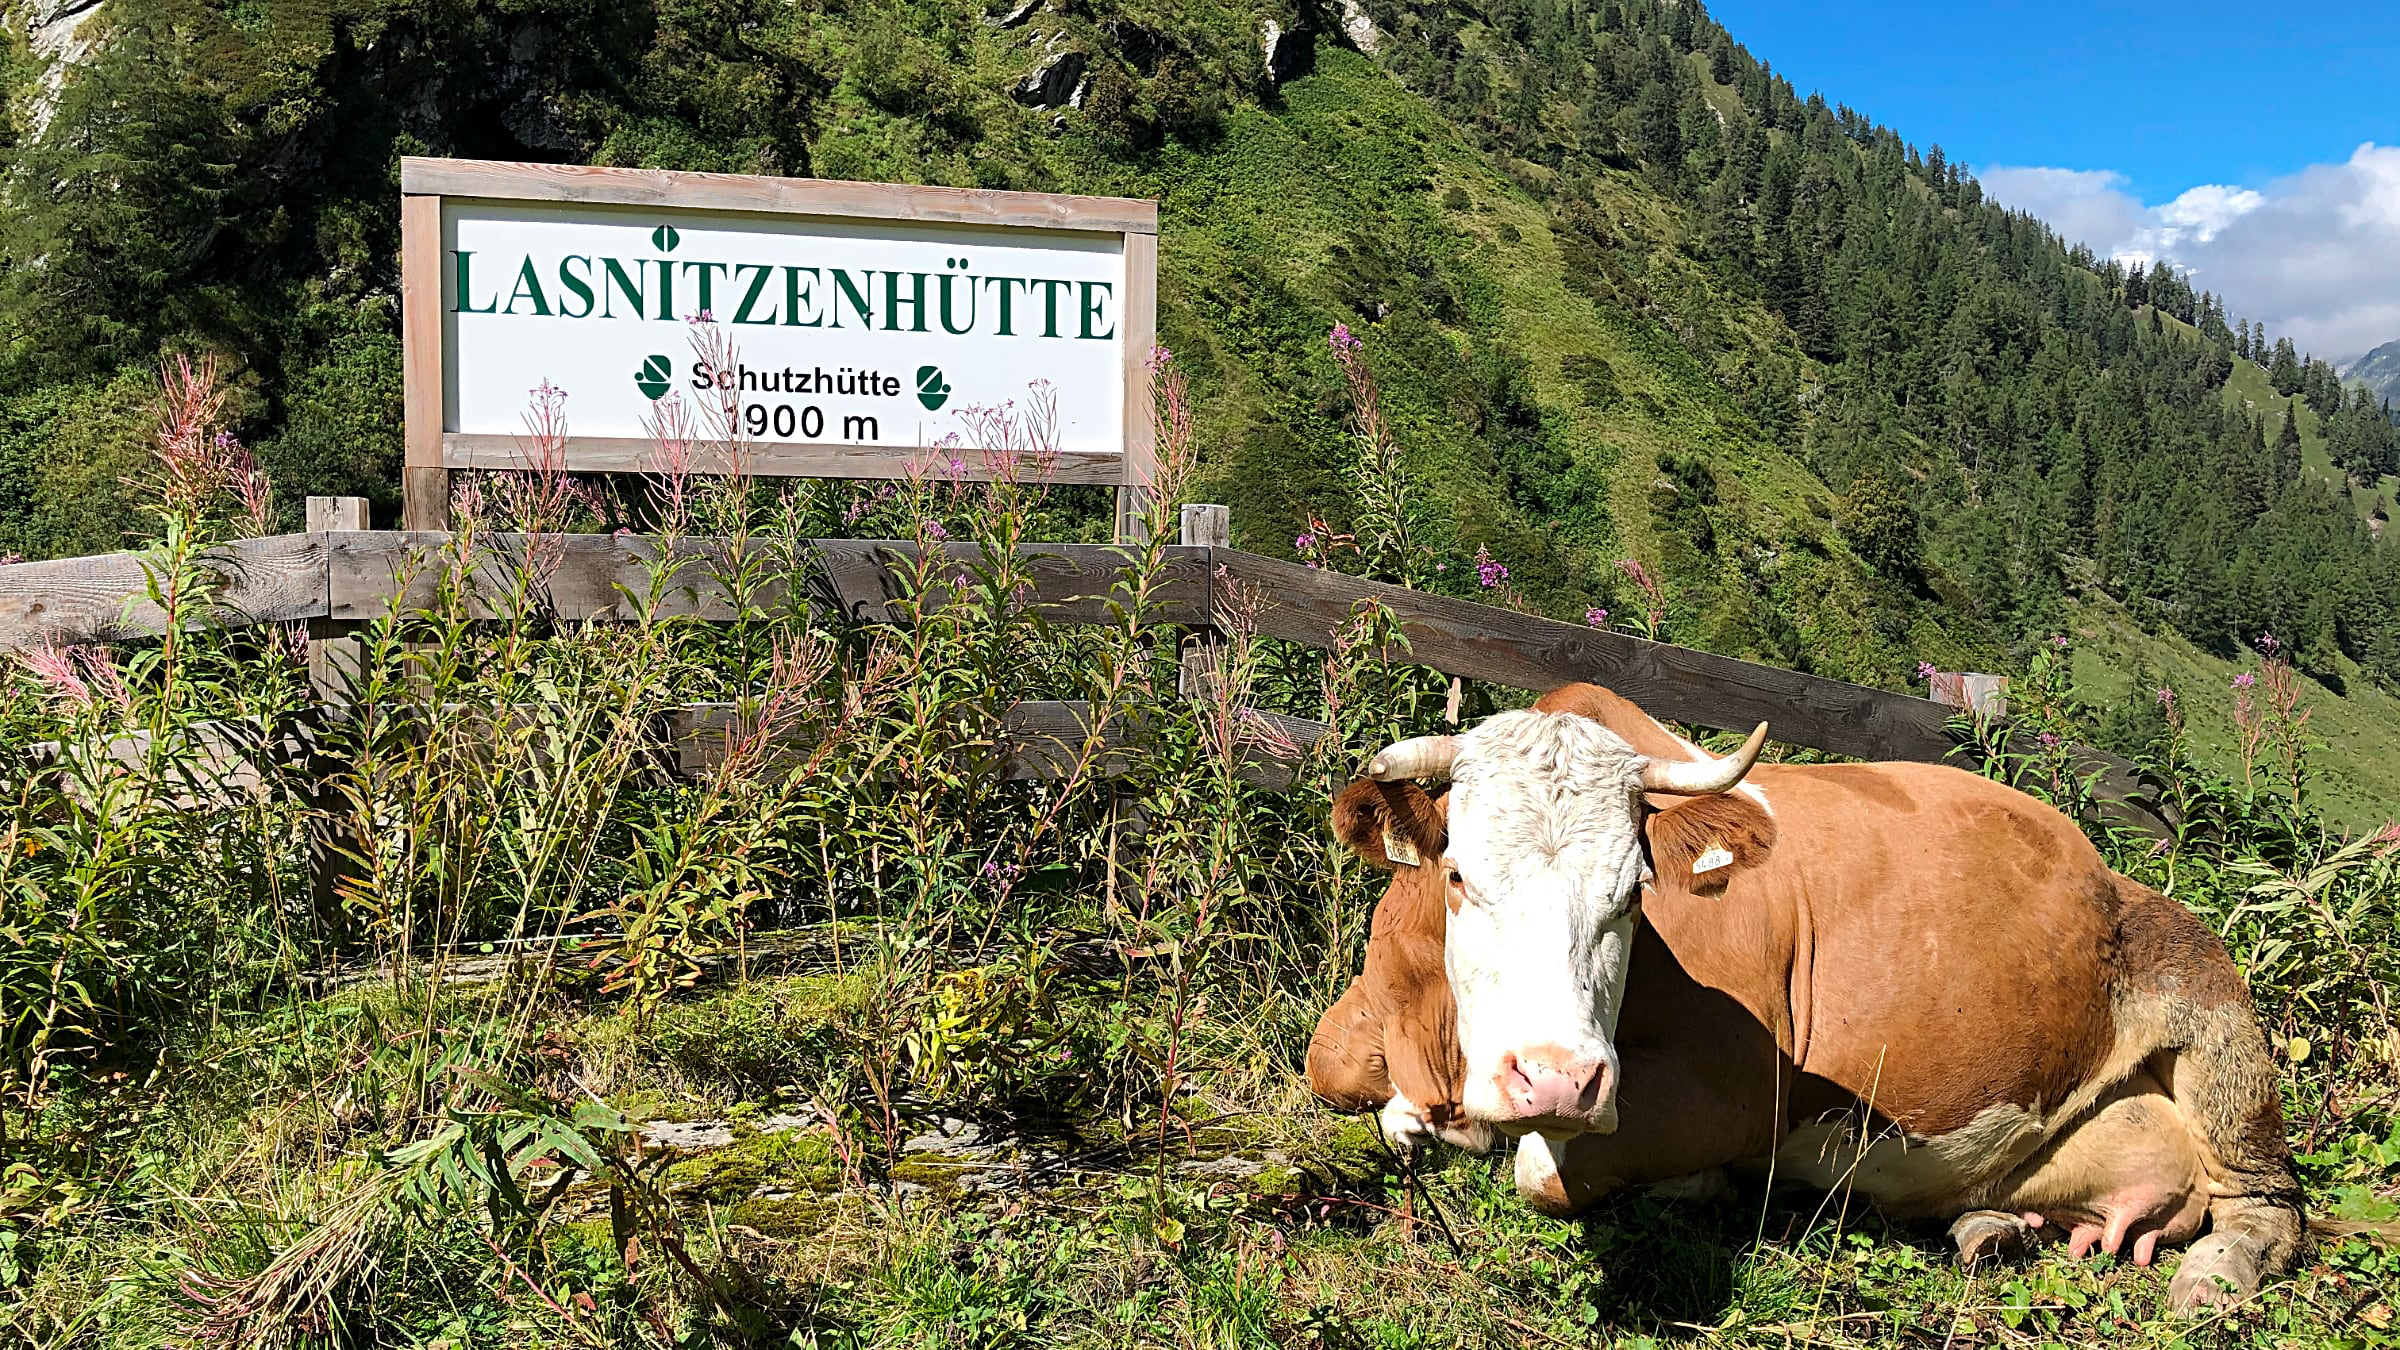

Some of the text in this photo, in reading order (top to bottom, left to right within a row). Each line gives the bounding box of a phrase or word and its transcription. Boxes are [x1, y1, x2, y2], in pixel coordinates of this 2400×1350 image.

[450, 224, 1115, 340] LASNITZENHÜTTE
[691, 362, 901, 397] Schutzhütte
[844, 415, 879, 440] m
